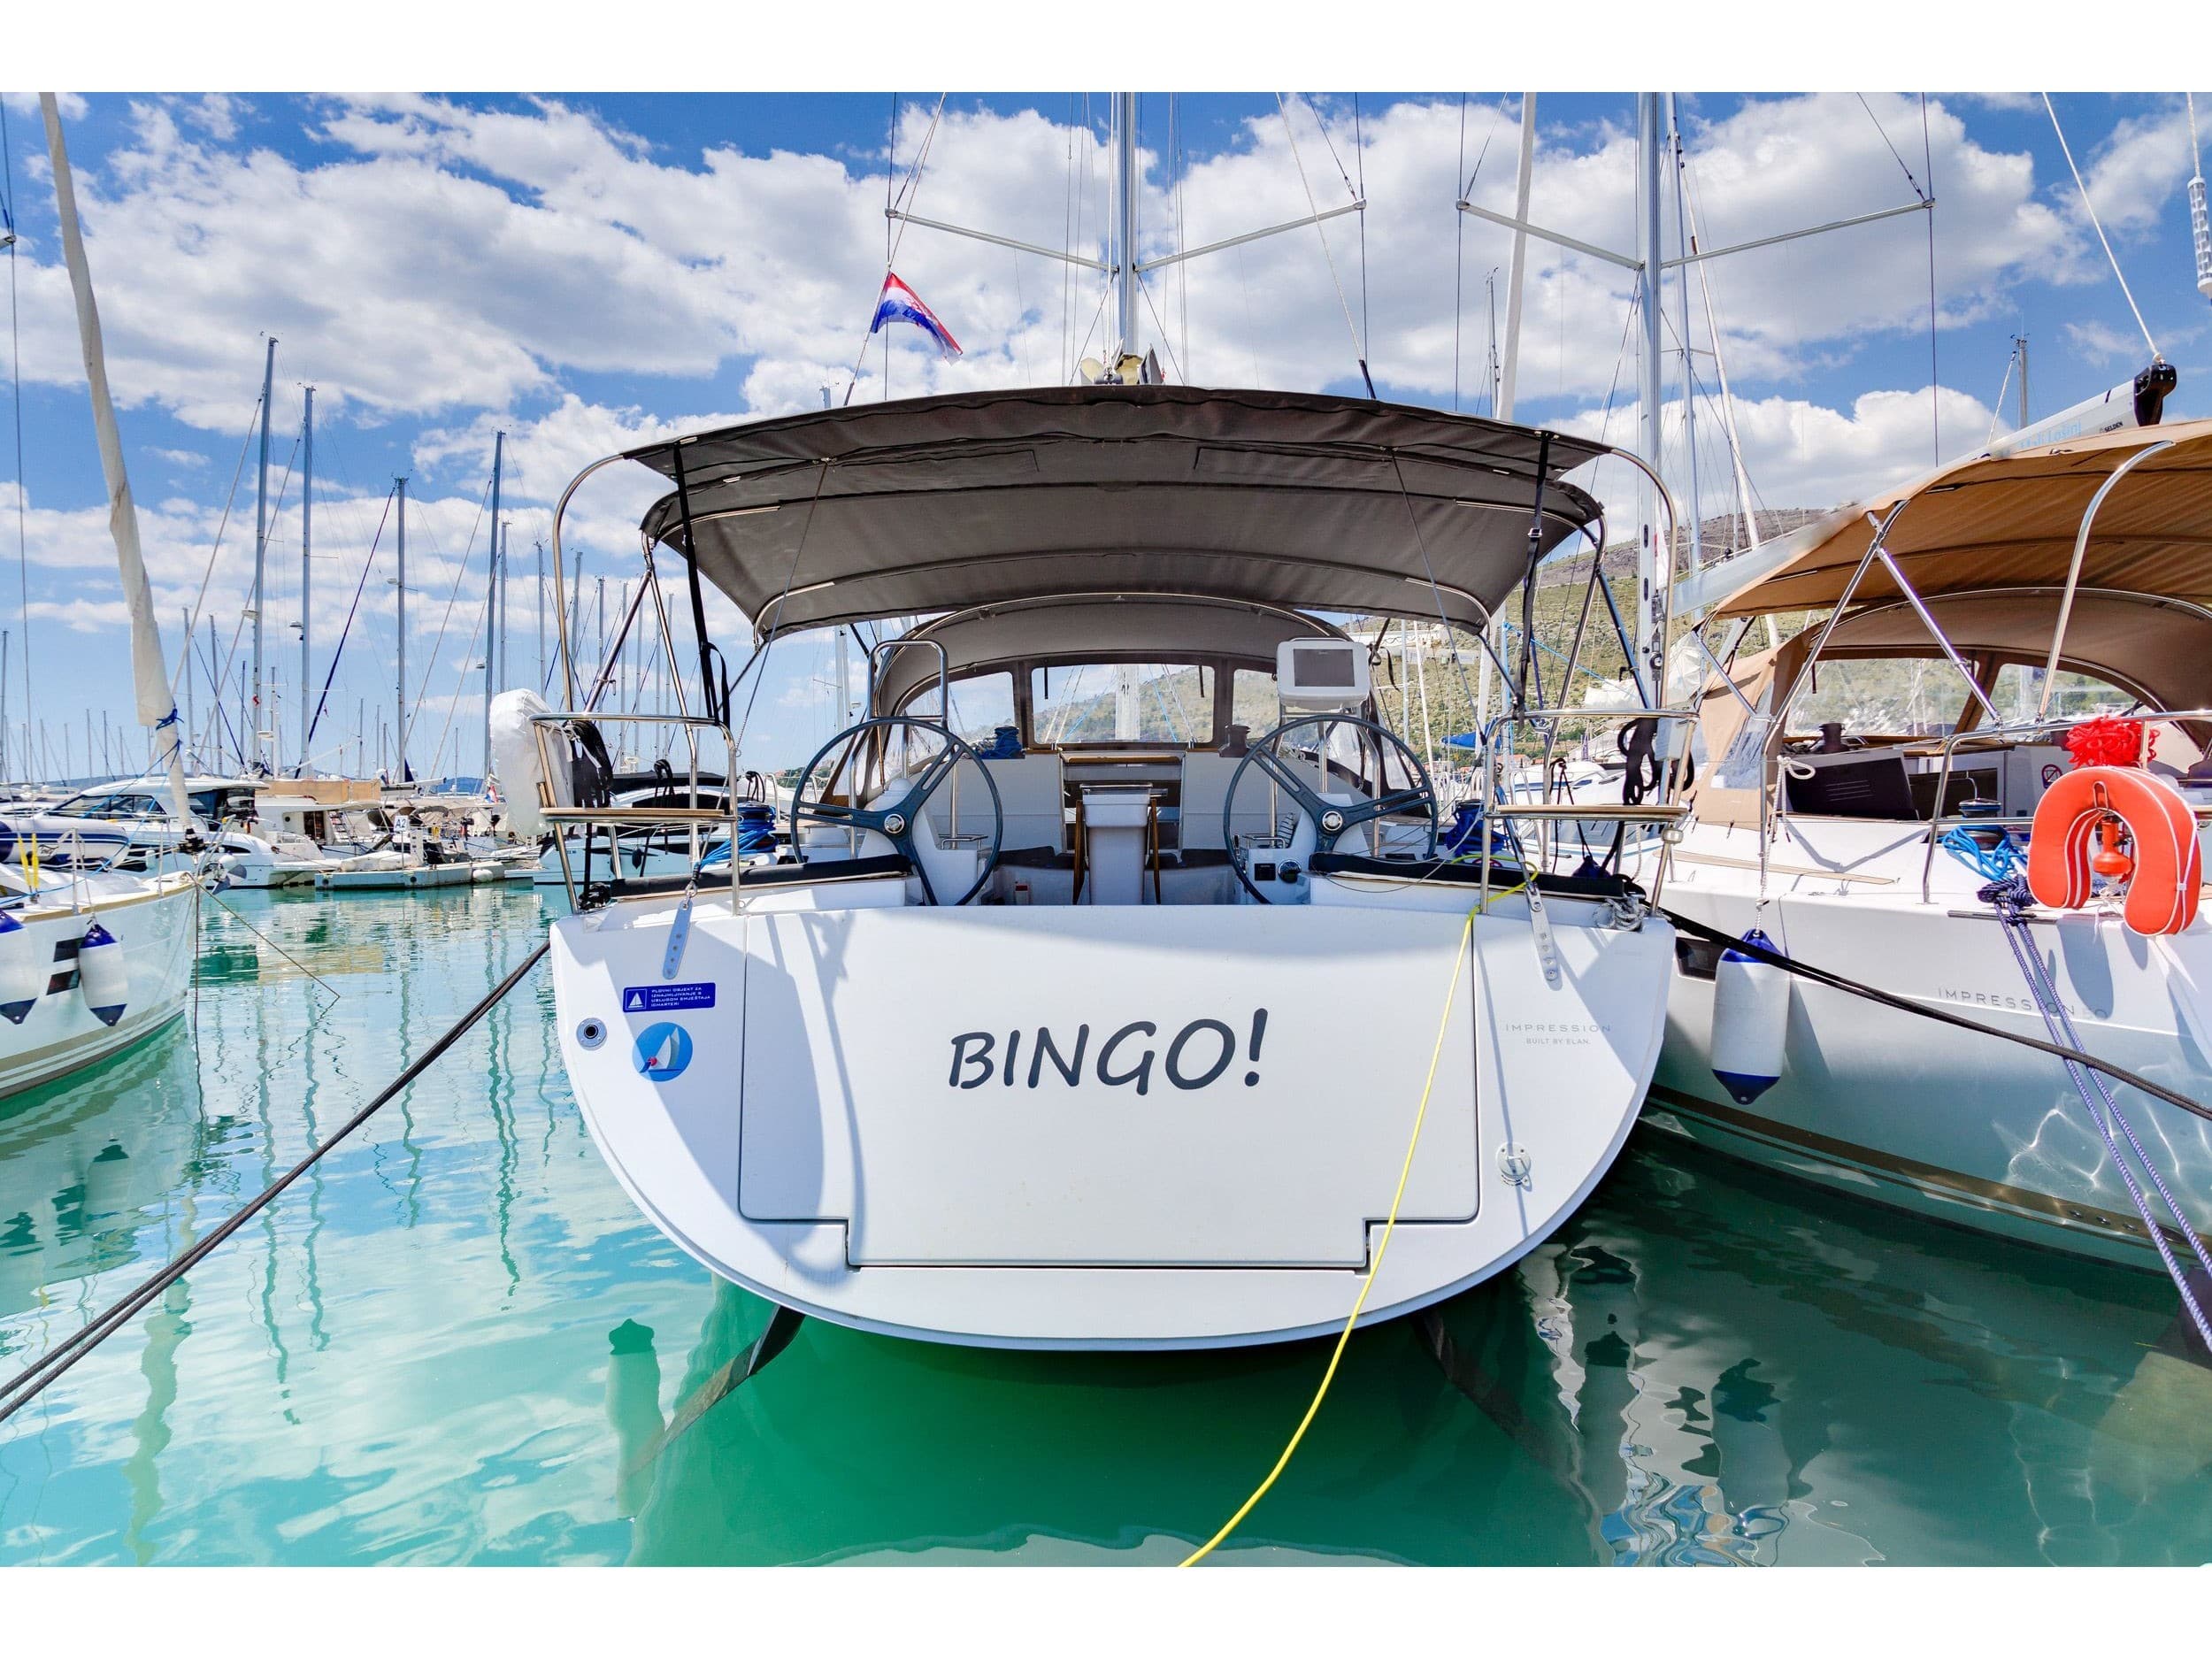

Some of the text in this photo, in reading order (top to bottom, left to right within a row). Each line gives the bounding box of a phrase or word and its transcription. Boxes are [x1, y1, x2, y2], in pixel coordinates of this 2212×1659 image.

[396, 818, 406, 828] A2
[1938, 987, 2075, 1016] IMPRESSON
[1506, 1024, 1611, 1033] IMPRESSION
[949, 1008, 1268, 1096] BINGO!
